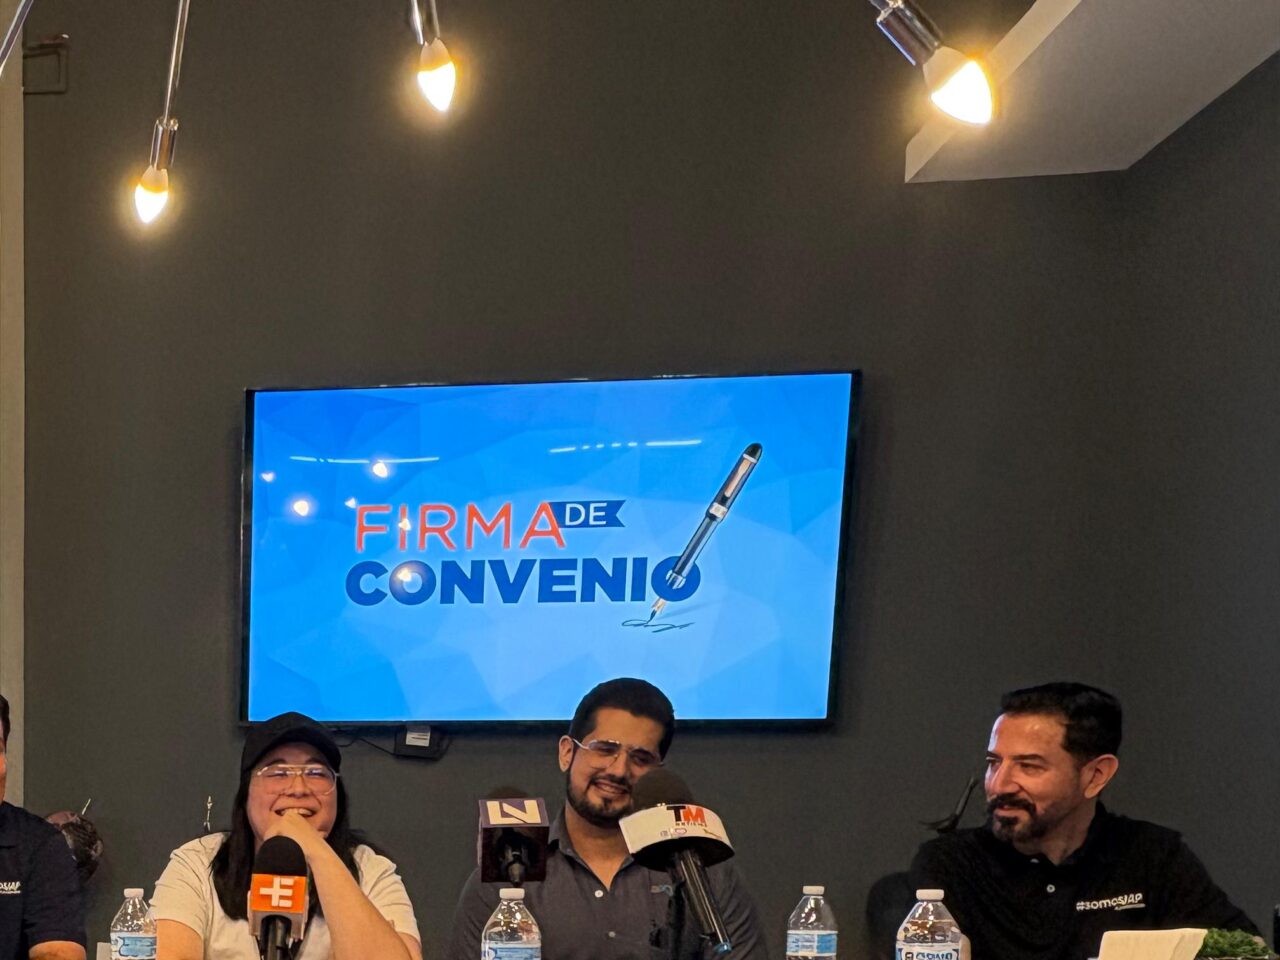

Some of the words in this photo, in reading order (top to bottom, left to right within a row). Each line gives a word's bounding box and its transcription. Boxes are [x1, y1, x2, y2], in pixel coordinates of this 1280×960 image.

[355, 501, 566, 552] FIRMA
[564, 502, 607, 526] DE
[345, 556, 701, 606] CONVENIO
[667, 805, 706, 823] TM
